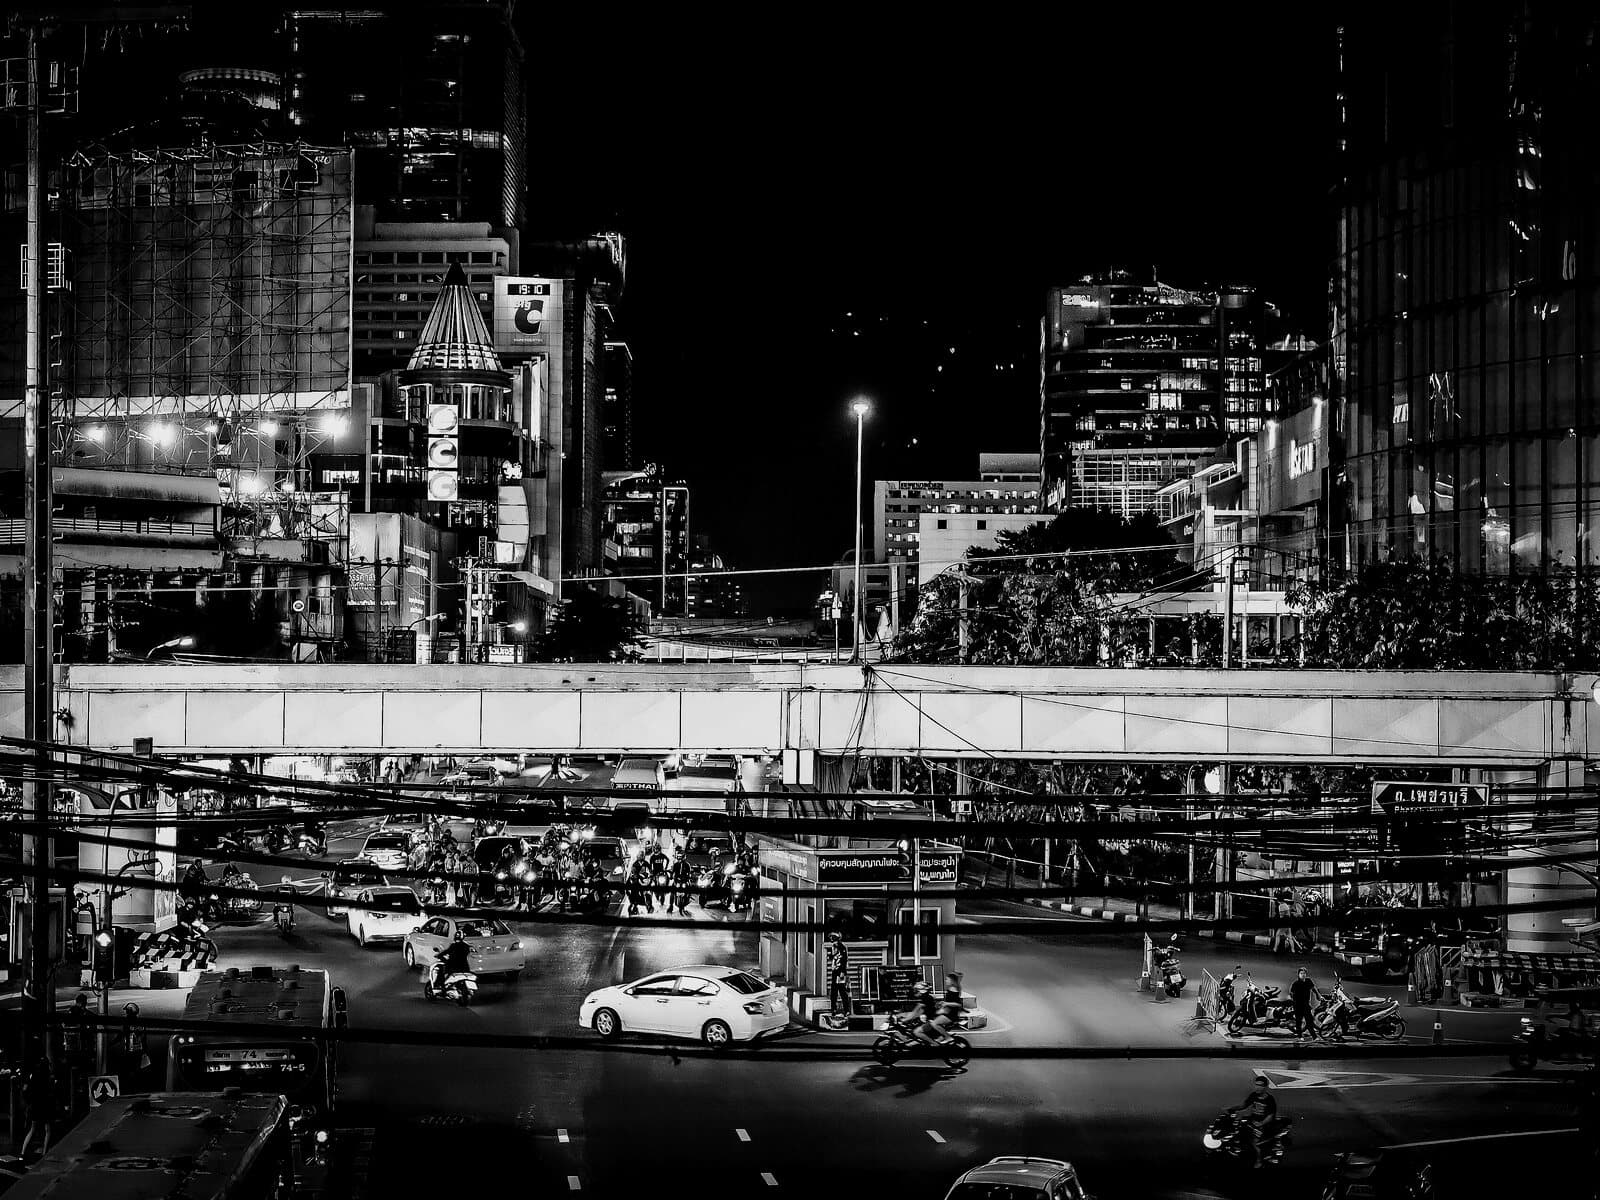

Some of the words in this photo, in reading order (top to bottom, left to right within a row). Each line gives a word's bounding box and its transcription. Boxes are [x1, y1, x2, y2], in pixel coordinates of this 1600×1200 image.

[519, 284, 543, 295] 19:10
[241, 1050, 258, 1060] 74
[280, 1063, 305, 1072] 74-5
